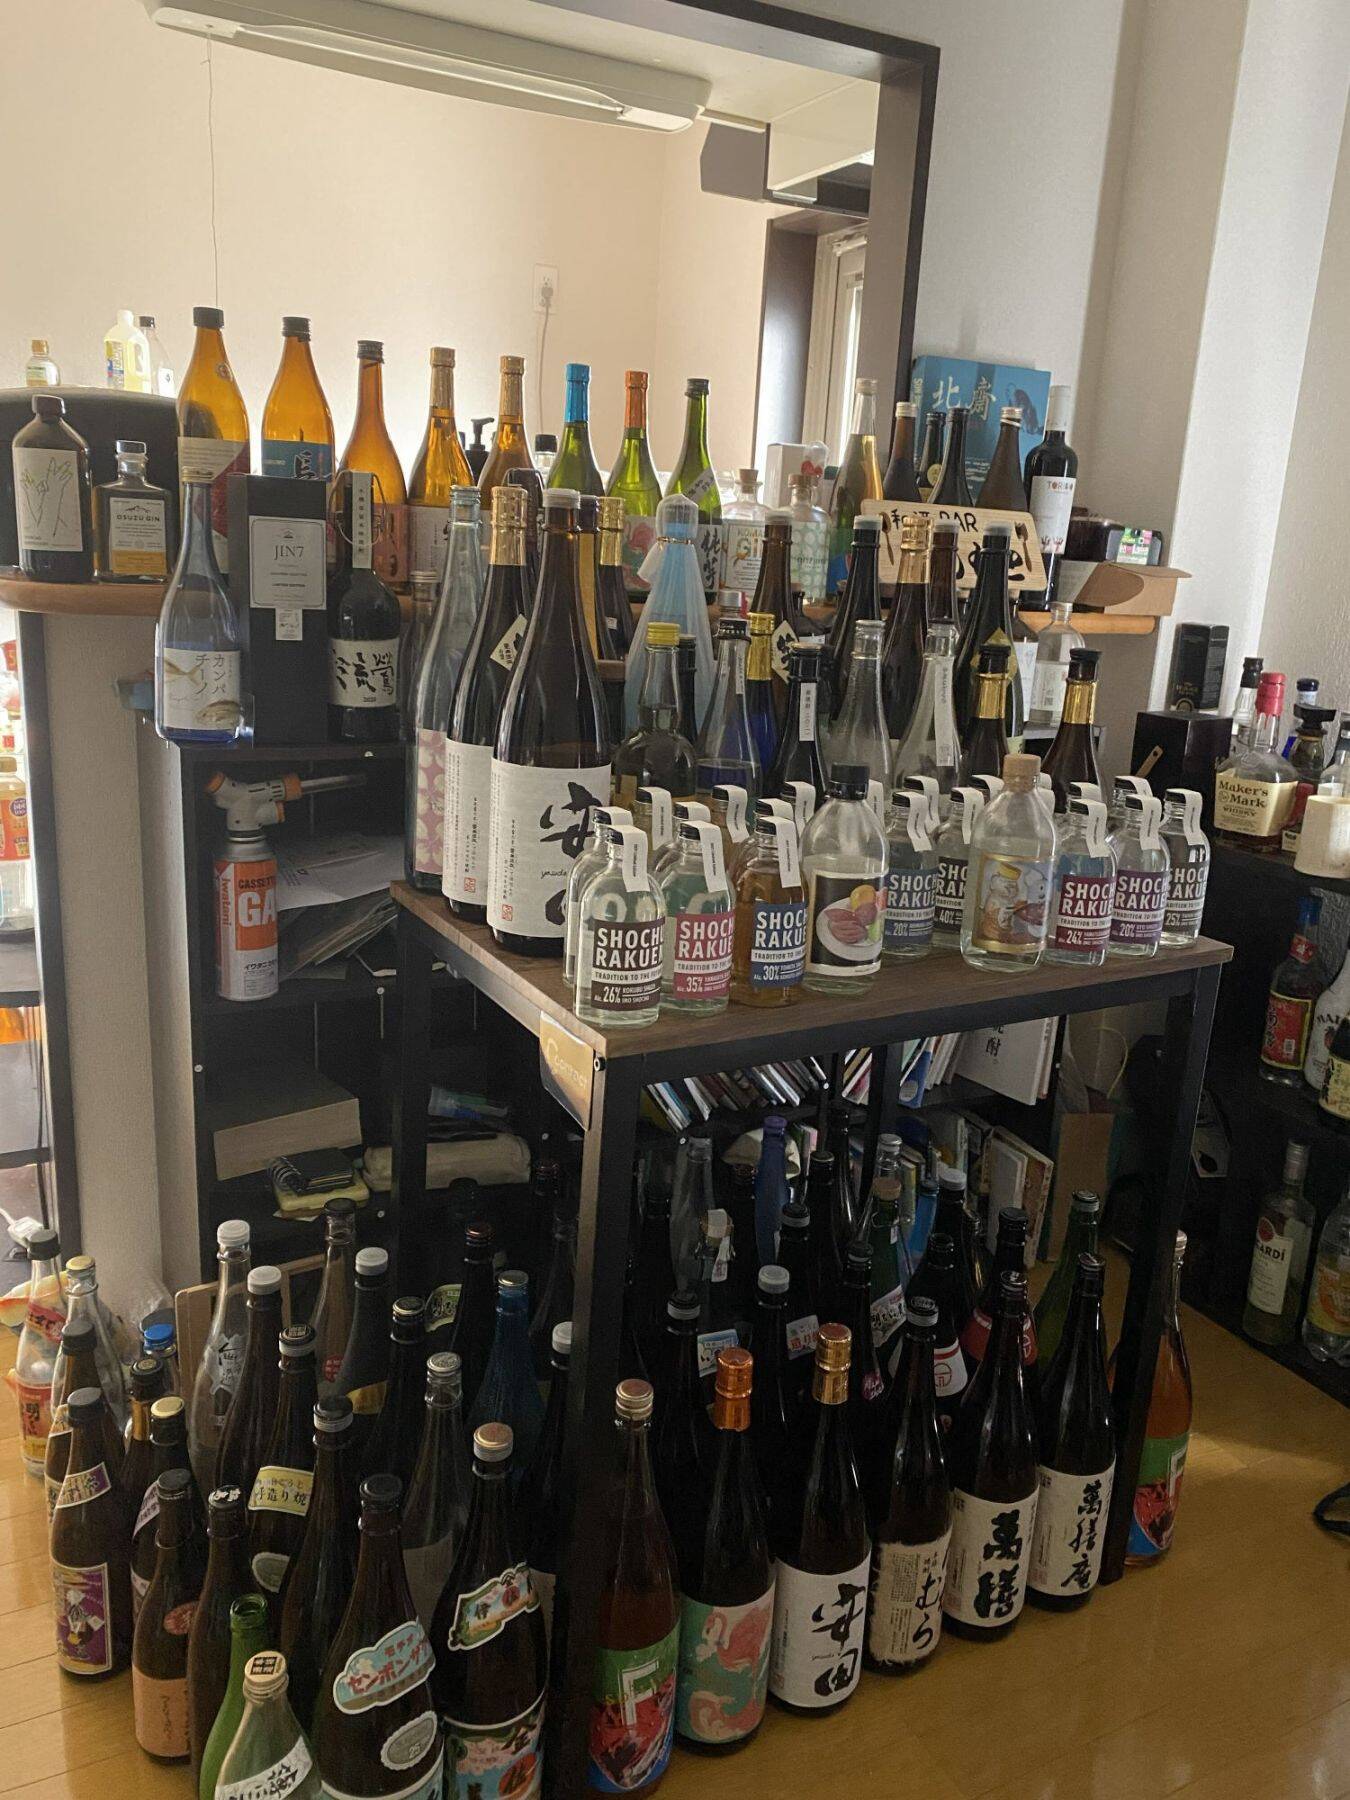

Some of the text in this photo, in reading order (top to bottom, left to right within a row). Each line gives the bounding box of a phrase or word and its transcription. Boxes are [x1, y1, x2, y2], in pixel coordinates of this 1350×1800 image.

[195, 653, 210, 695] チーノ
[213, 655, 227, 694] カンパ
[1219, 780, 1269, 797] Maker's
[1229, 793, 1266, 808] Mark
[595, 971, 629, 981] TRADITION
[763, 965, 780, 981] 30%
[686, 976, 703, 993] 35%
[603, 985, 621, 1004] 26%
